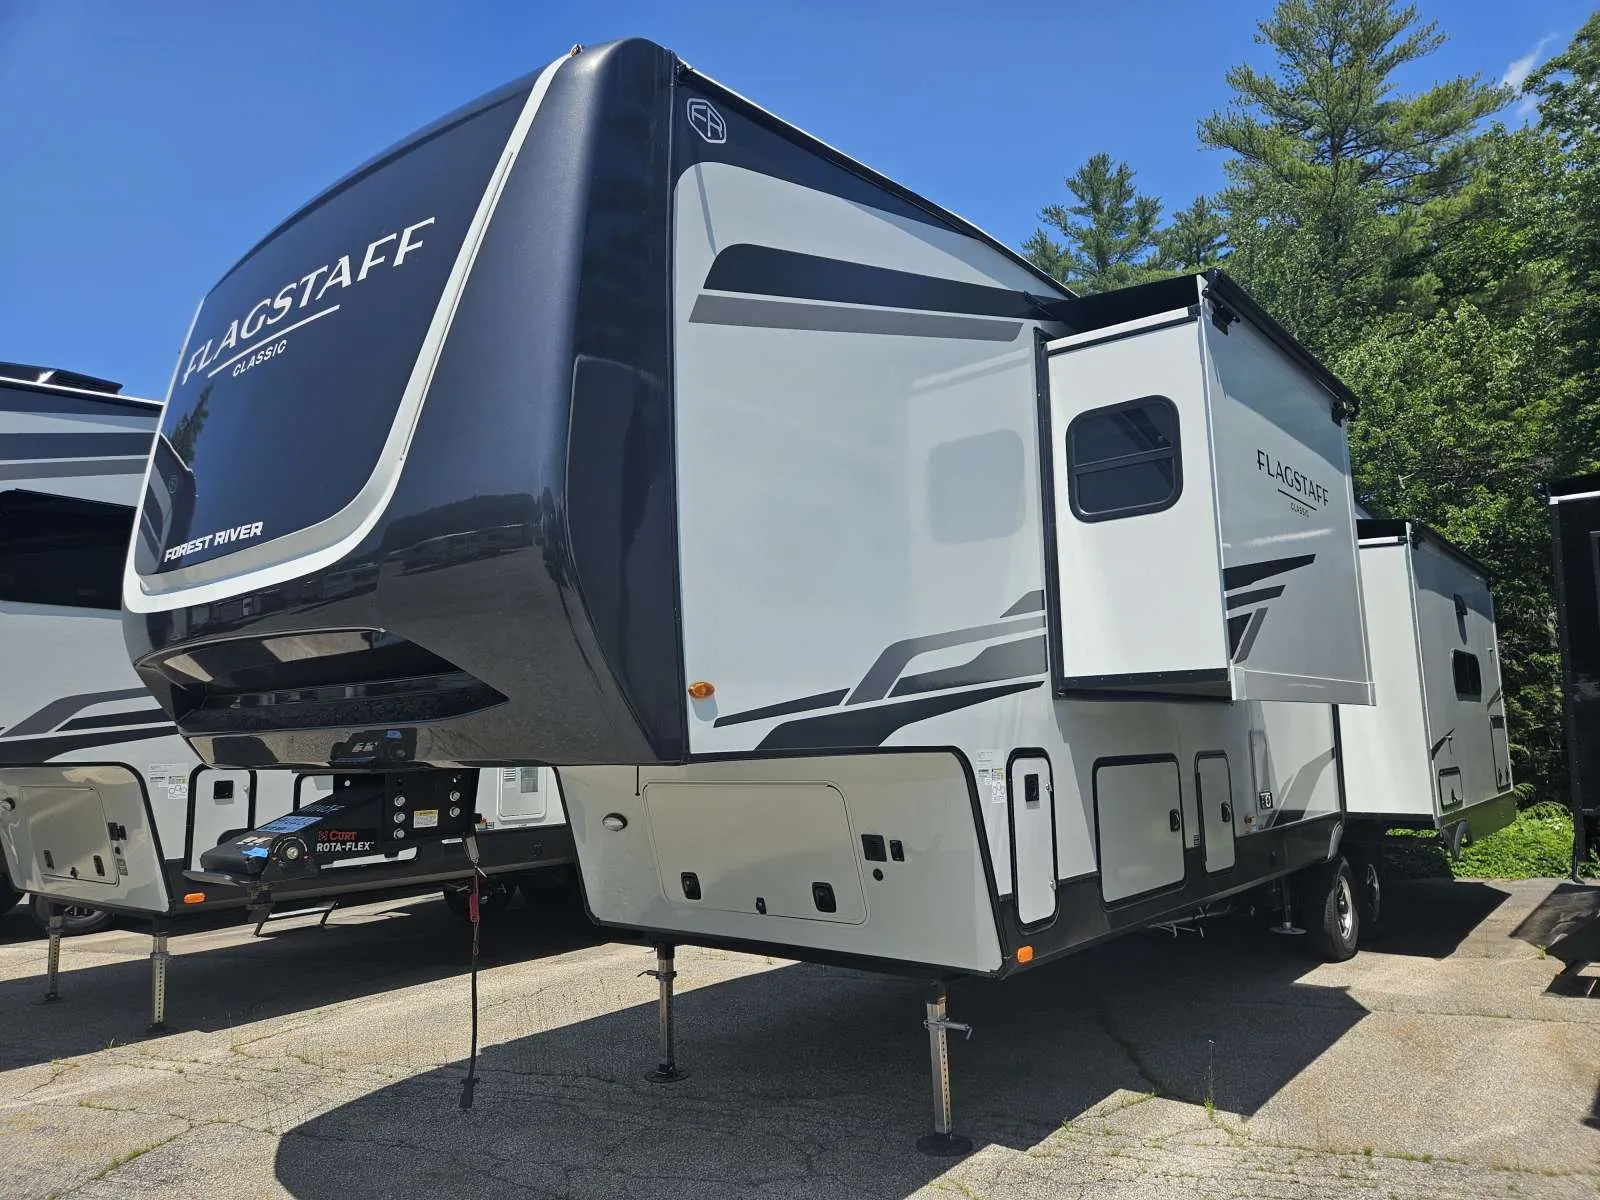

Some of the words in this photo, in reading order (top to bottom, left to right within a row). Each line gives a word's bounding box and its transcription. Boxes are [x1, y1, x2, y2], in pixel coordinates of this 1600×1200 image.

[182, 216, 435, 386] FLAGSTAFF
[232, 339, 288, 377] CLASSIC
[1256, 449, 1329, 506] FLAGSTAFF
[164, 534, 214, 563] FOREST
[214, 521, 264, 546] RIVER
